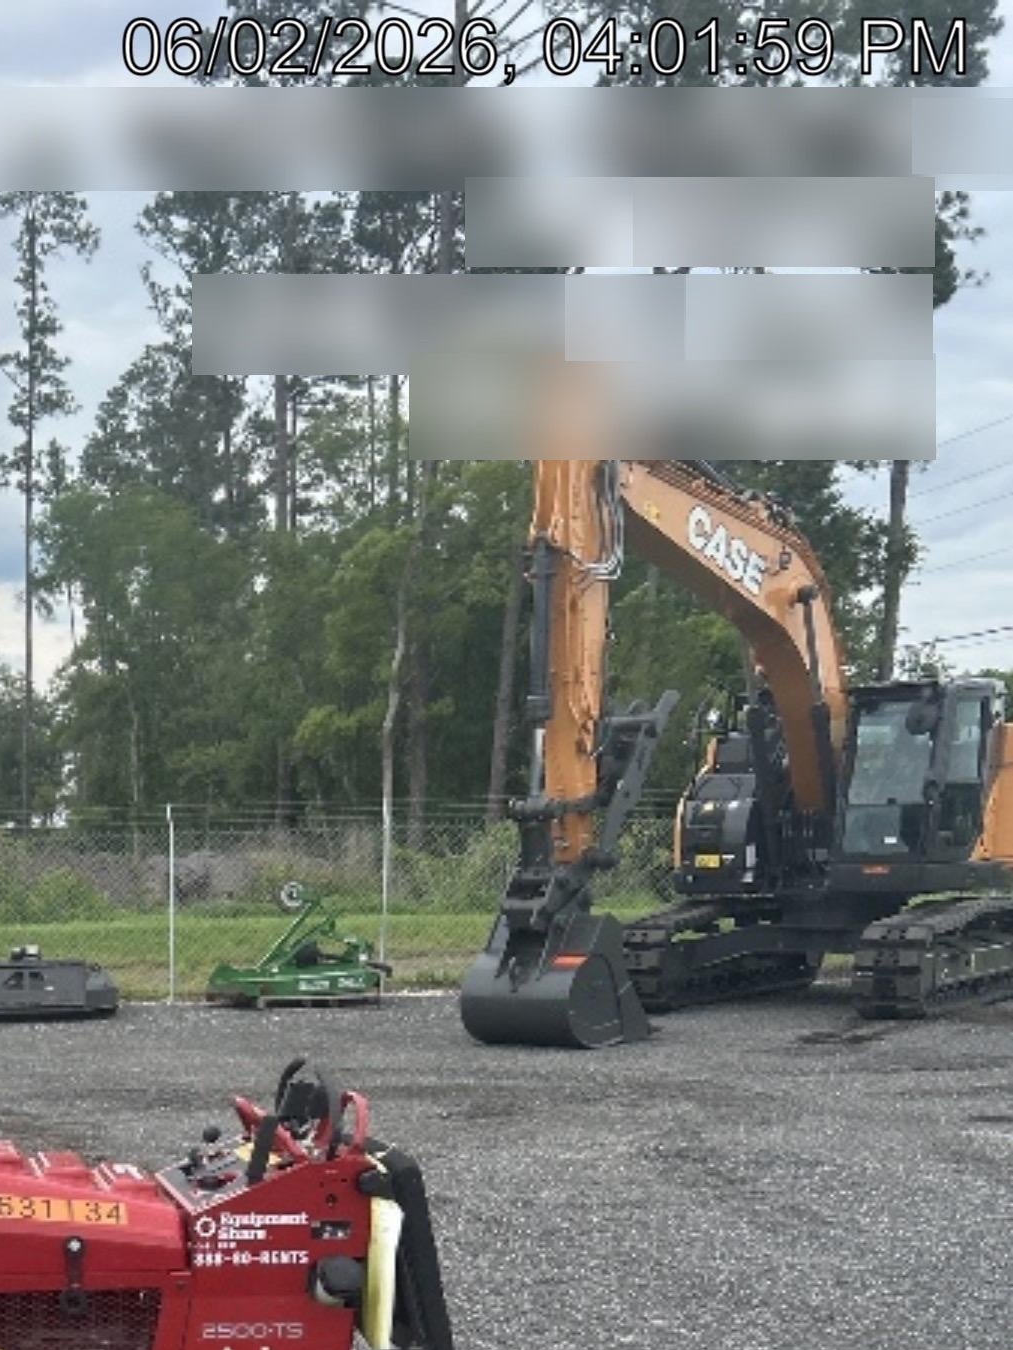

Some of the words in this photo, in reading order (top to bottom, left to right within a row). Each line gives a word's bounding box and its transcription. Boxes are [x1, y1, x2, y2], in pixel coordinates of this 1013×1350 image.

[688, 505, 766, 596] CASE
[219, 1211, 310, 1227] Equipment
[218, 1228, 267, 1240] Share
